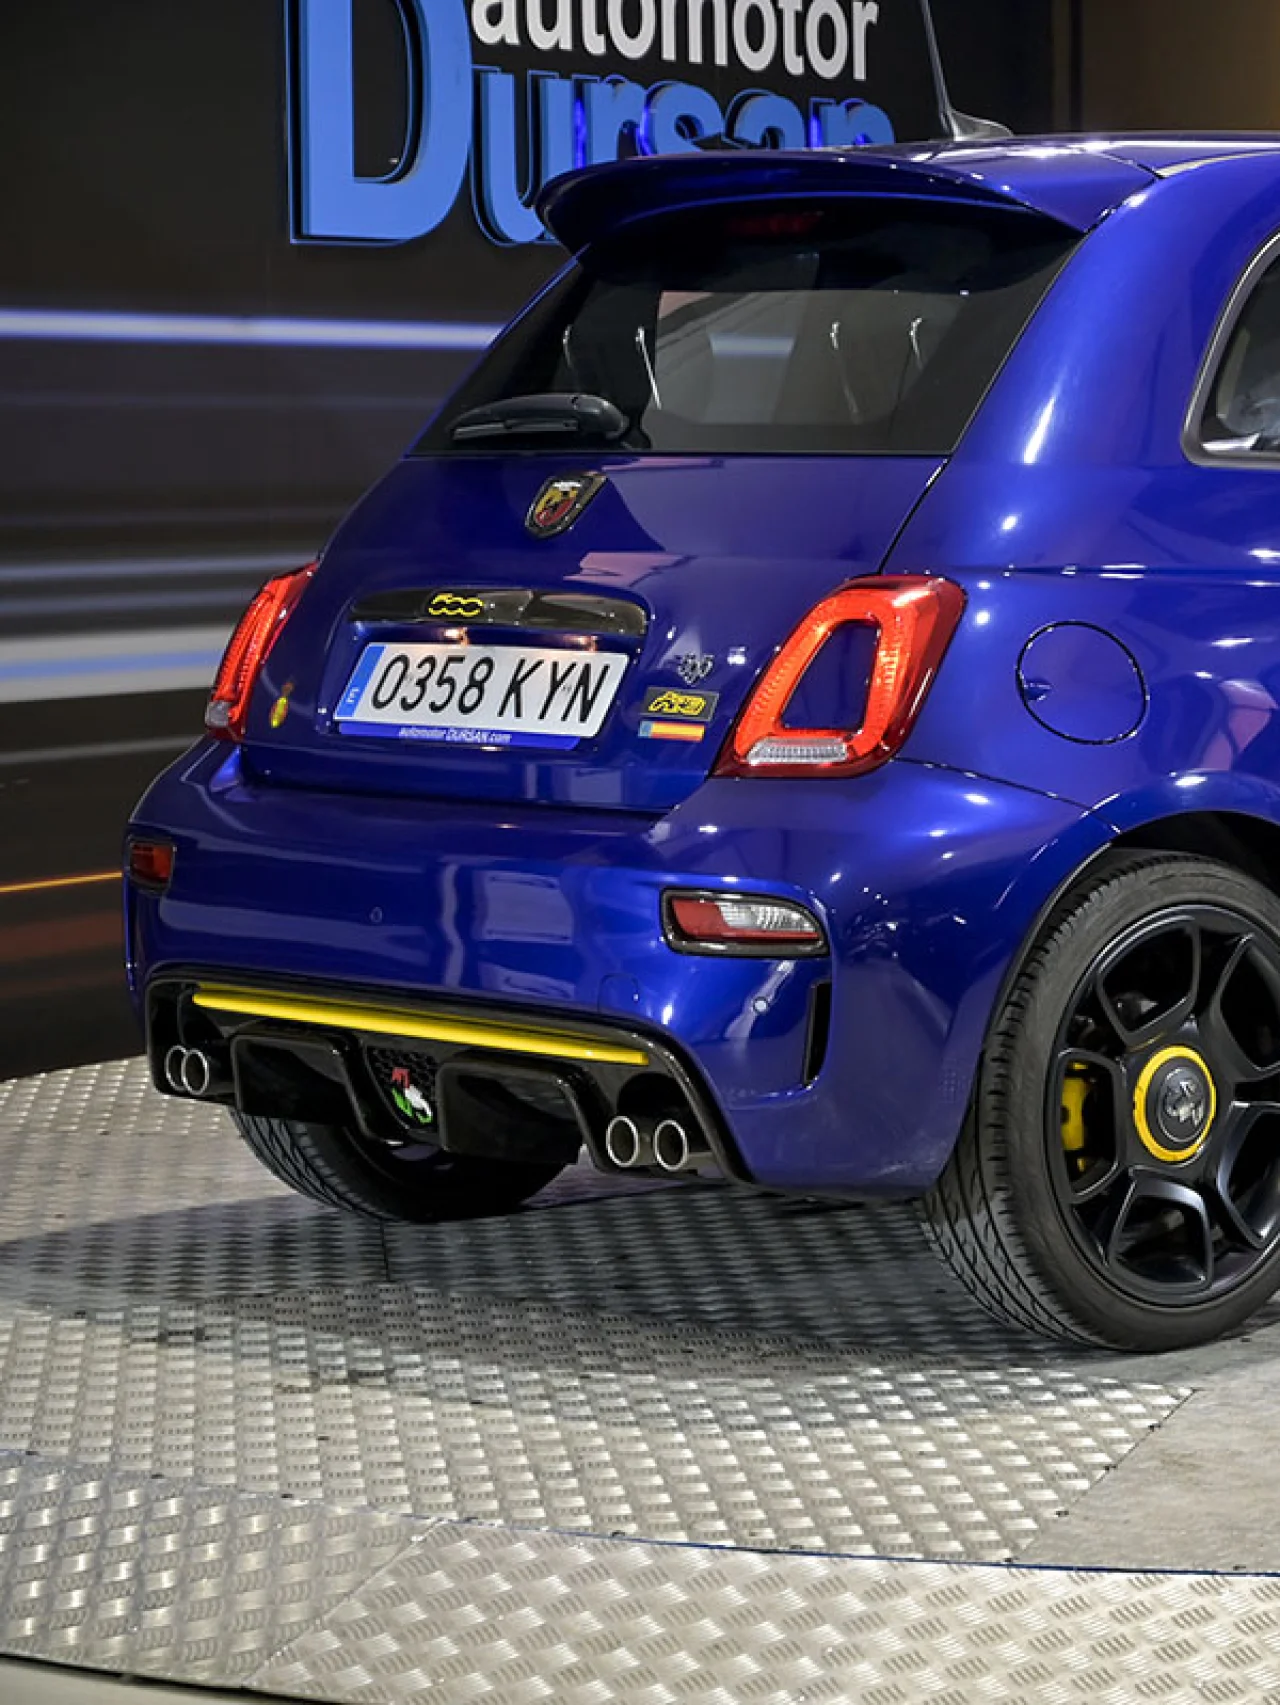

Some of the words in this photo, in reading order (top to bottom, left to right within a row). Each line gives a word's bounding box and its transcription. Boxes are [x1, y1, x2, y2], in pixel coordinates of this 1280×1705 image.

[471, 0, 878, 81] automotor
[371, 654, 494, 715] 0358
[497, 658, 611, 724] KYN
